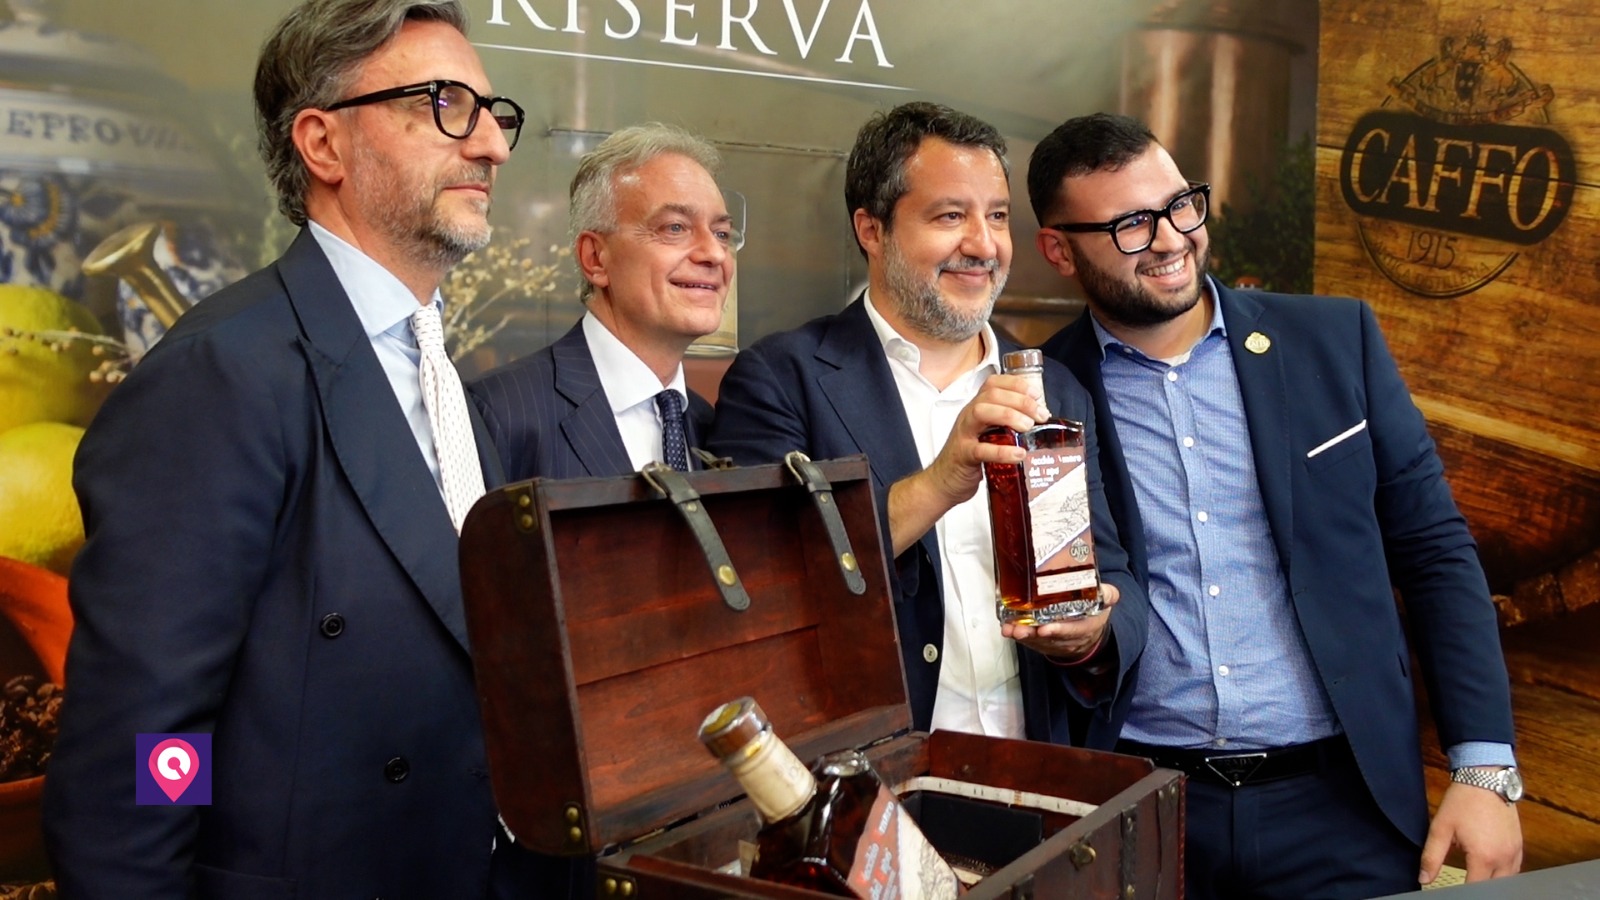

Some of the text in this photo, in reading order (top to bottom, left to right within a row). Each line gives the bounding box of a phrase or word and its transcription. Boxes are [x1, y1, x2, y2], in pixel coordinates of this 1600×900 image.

[1350, 127, 1560, 231] CAFFO
[1404, 230, 1459, 269] 1915
[1042, 466, 1060, 479] apo
